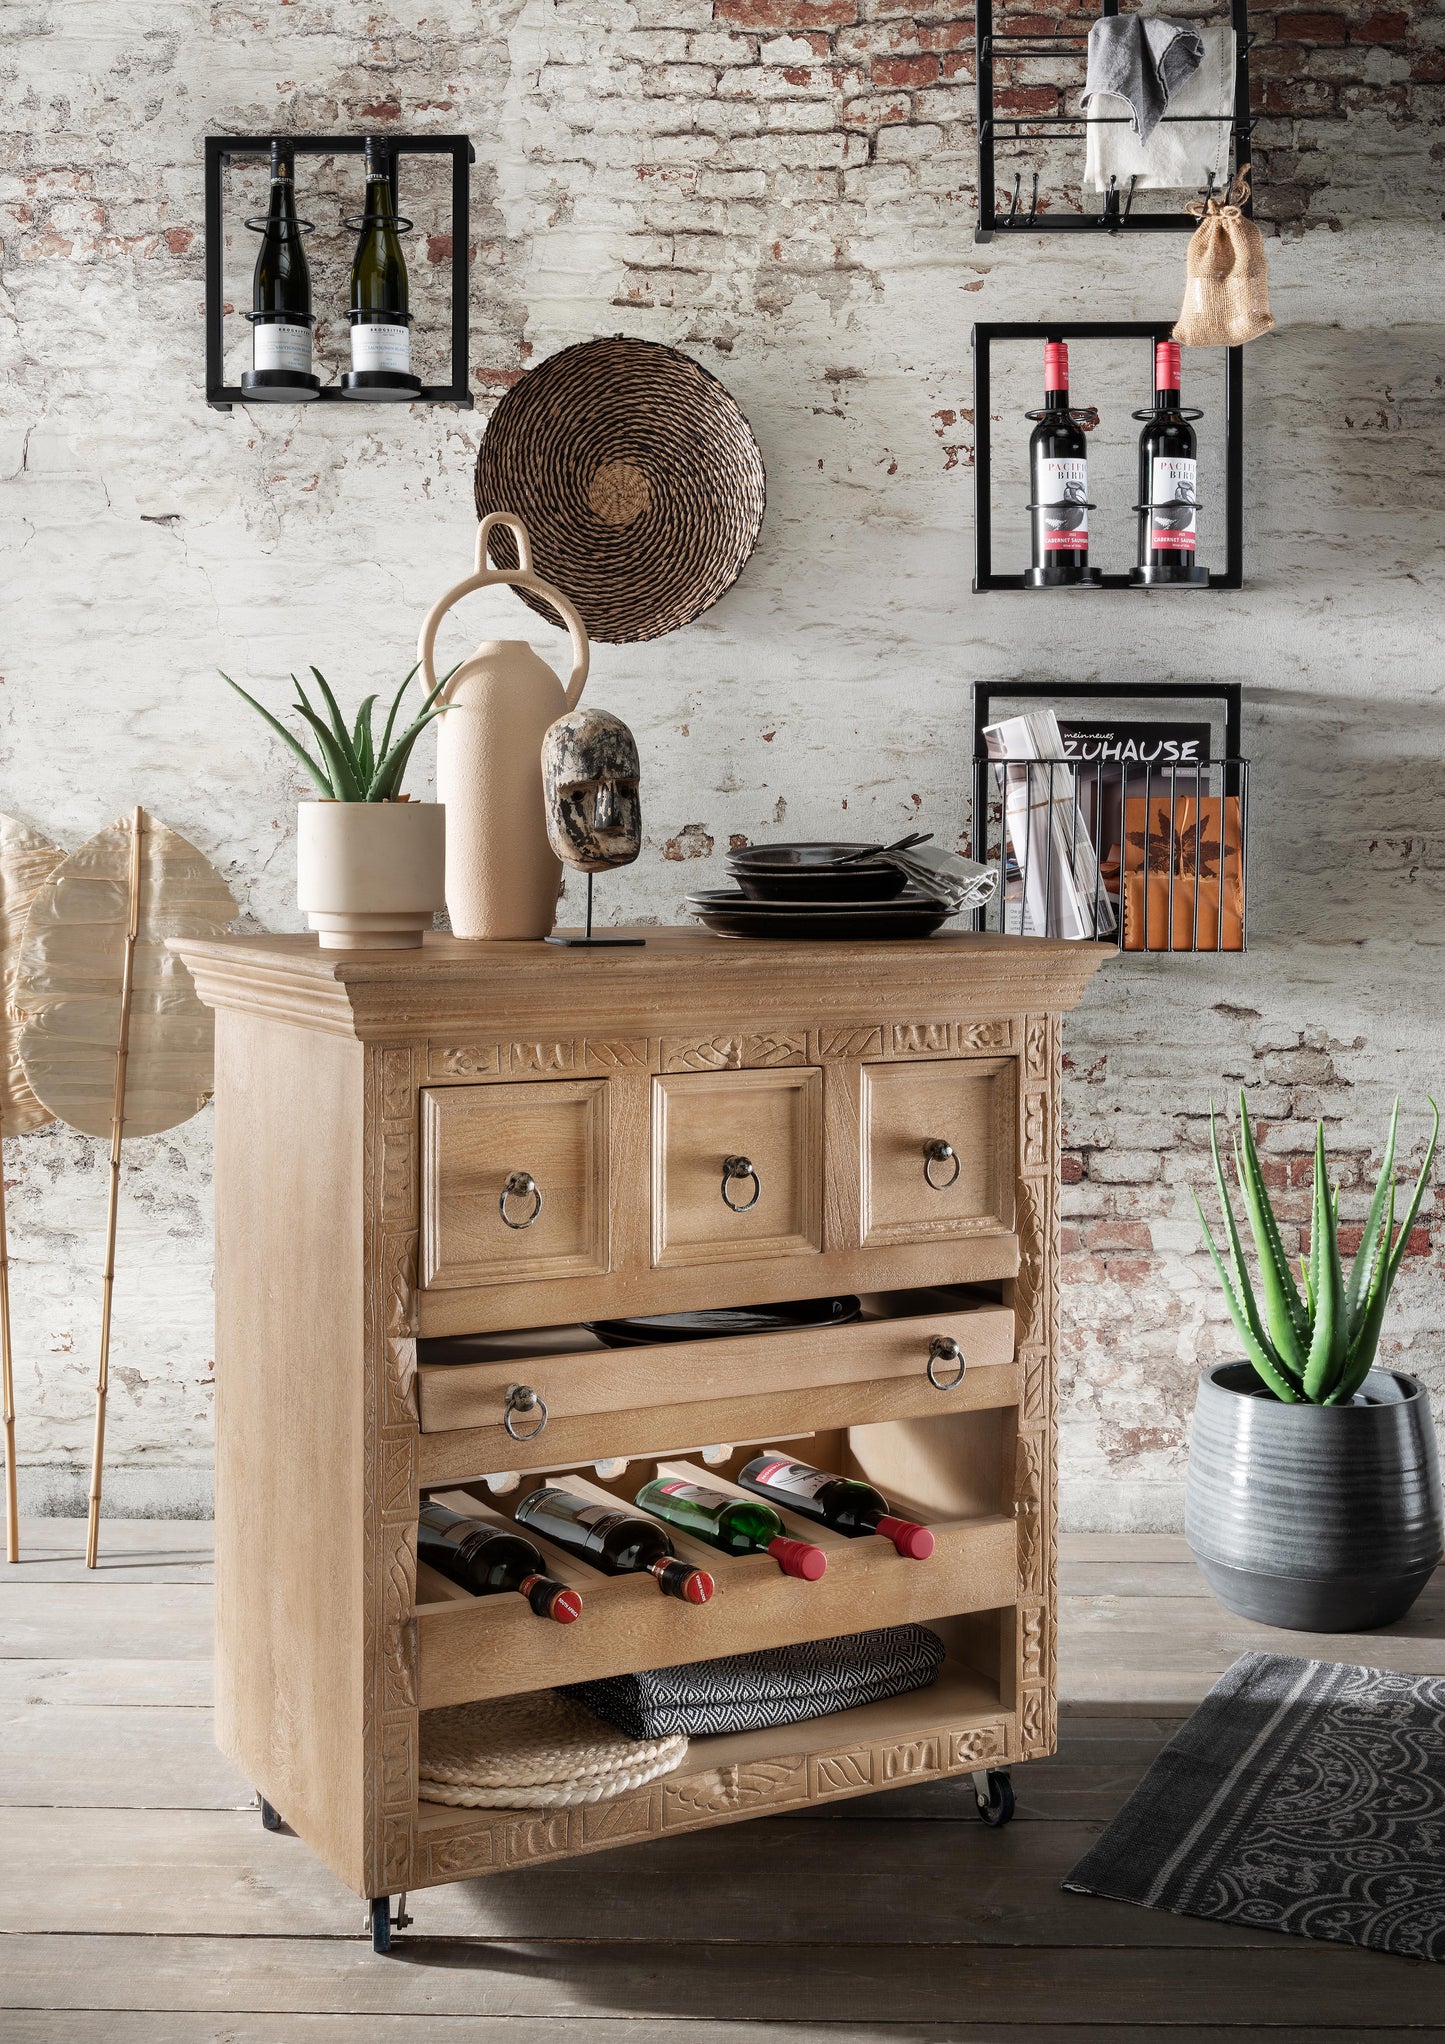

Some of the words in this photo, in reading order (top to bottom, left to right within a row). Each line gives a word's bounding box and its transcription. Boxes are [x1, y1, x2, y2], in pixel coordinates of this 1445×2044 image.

[1057, 471, 1084, 480] BIRD
[1169, 471, 1194, 480] BIRD
[1088, 732, 1115, 741] neues
[1063, 739, 1200, 761] ZUHAUSE
